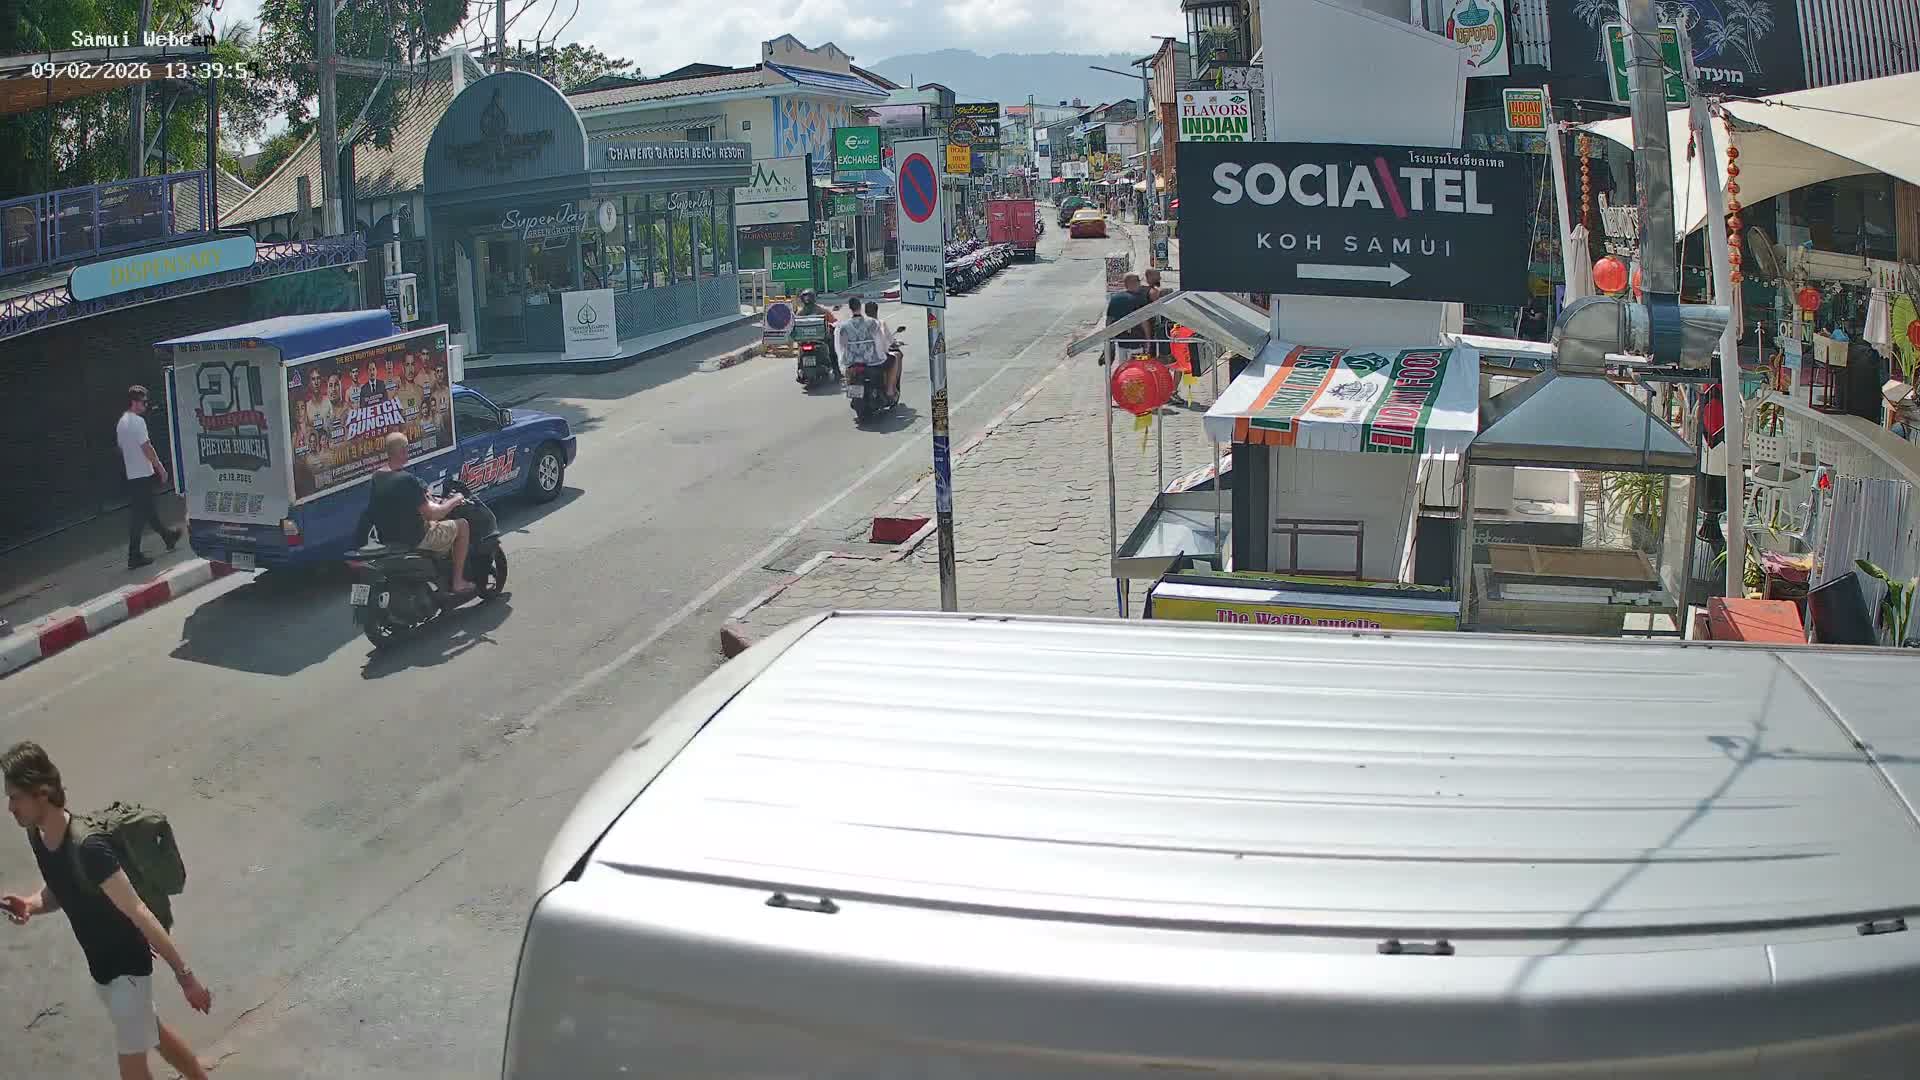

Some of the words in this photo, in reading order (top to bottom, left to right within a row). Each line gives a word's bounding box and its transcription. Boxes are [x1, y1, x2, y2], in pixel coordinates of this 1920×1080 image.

[1183, 104, 1248, 116] FLAVORS
[1508, 101, 1542, 113] INDIAN
[1182, 117, 1248, 134] INDIAN
[1511, 114, 1542, 127] FOOD
[608, 147, 654, 160] CHAWENG
[655, 147, 690, 159] GARDEN
[692, 147, 716, 159] BEACH
[720, 147, 745, 159] RESORT
[838, 155, 878, 165] EXCHANGE
[501, 203, 587, 240] SuperJay
[1257, 233, 1321, 250] KOH
[1344, 236, 1450, 257] SAMUI
[111, 249, 223, 287] DISPENSARY
[773, 261, 810, 270] EXCHANGE
[905, 263, 913, 272] NO
[914, 264, 938, 274] PARKING
[347, 397, 404, 424] PHETCH
[347, 410, 405, 440] BUNCHA
[1369, 390, 1430, 450] INDIAN
[200, 438, 232, 457] PHETCH
[234, 438, 268, 460] BUNCHA
[1216, 609, 1249, 624] The
